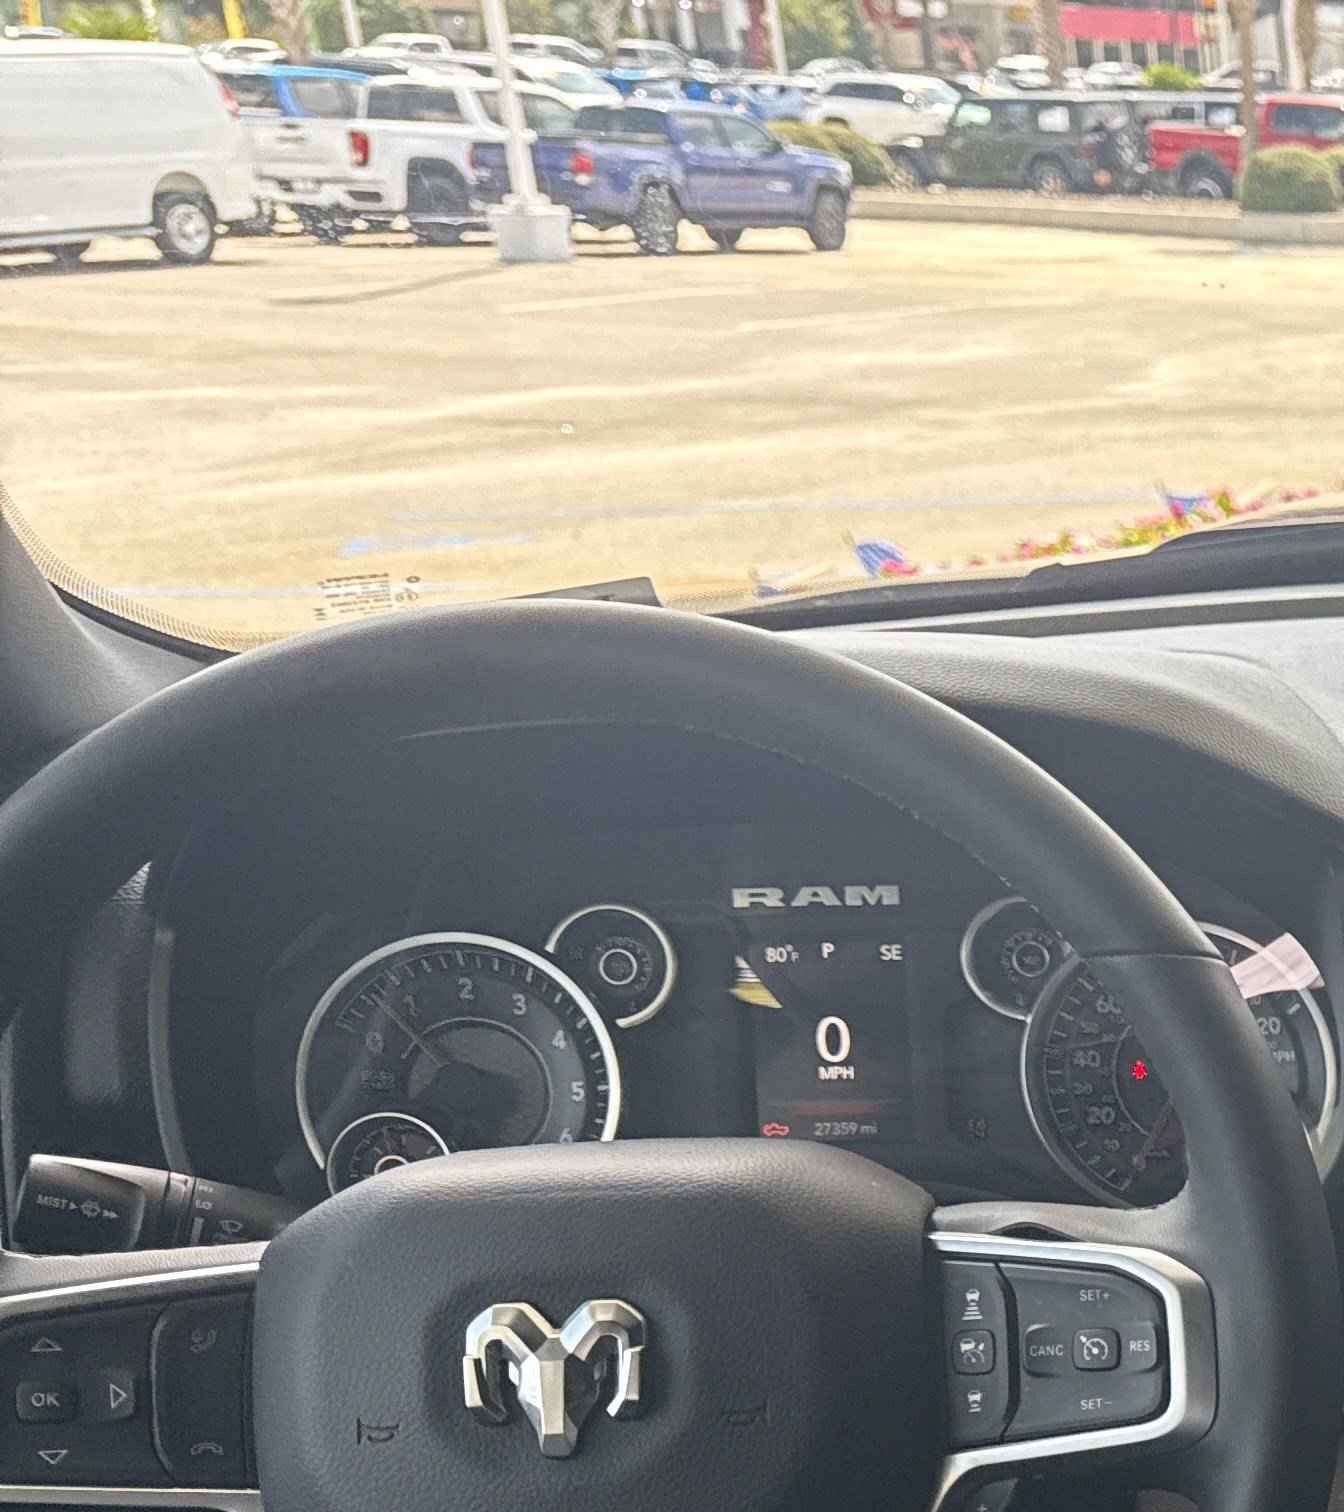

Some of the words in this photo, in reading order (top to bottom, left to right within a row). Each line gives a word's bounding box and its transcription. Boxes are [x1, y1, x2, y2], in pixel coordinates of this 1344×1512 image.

[732, 885, 900, 909] RAM
[820, 941, 836, 959] P
[878, 943, 903, 961] SE
[457, 976, 476, 1000] 2
[511, 992, 528, 1016] 3
[551, 1029, 567, 1050] 4
[815, 1015, 851, 1063] 0
[817, 1065, 855, 1080] MPH
[571, 1081, 586, 1102] 5
[812, 1121, 858, 1136] 27359
[860, 1119, 879, 1135] mi
[1029, 1344, 1065, 1357] CANC
[1129, 1339, 1151, 1352] RES
[30, 1392, 60, 1408] OK
